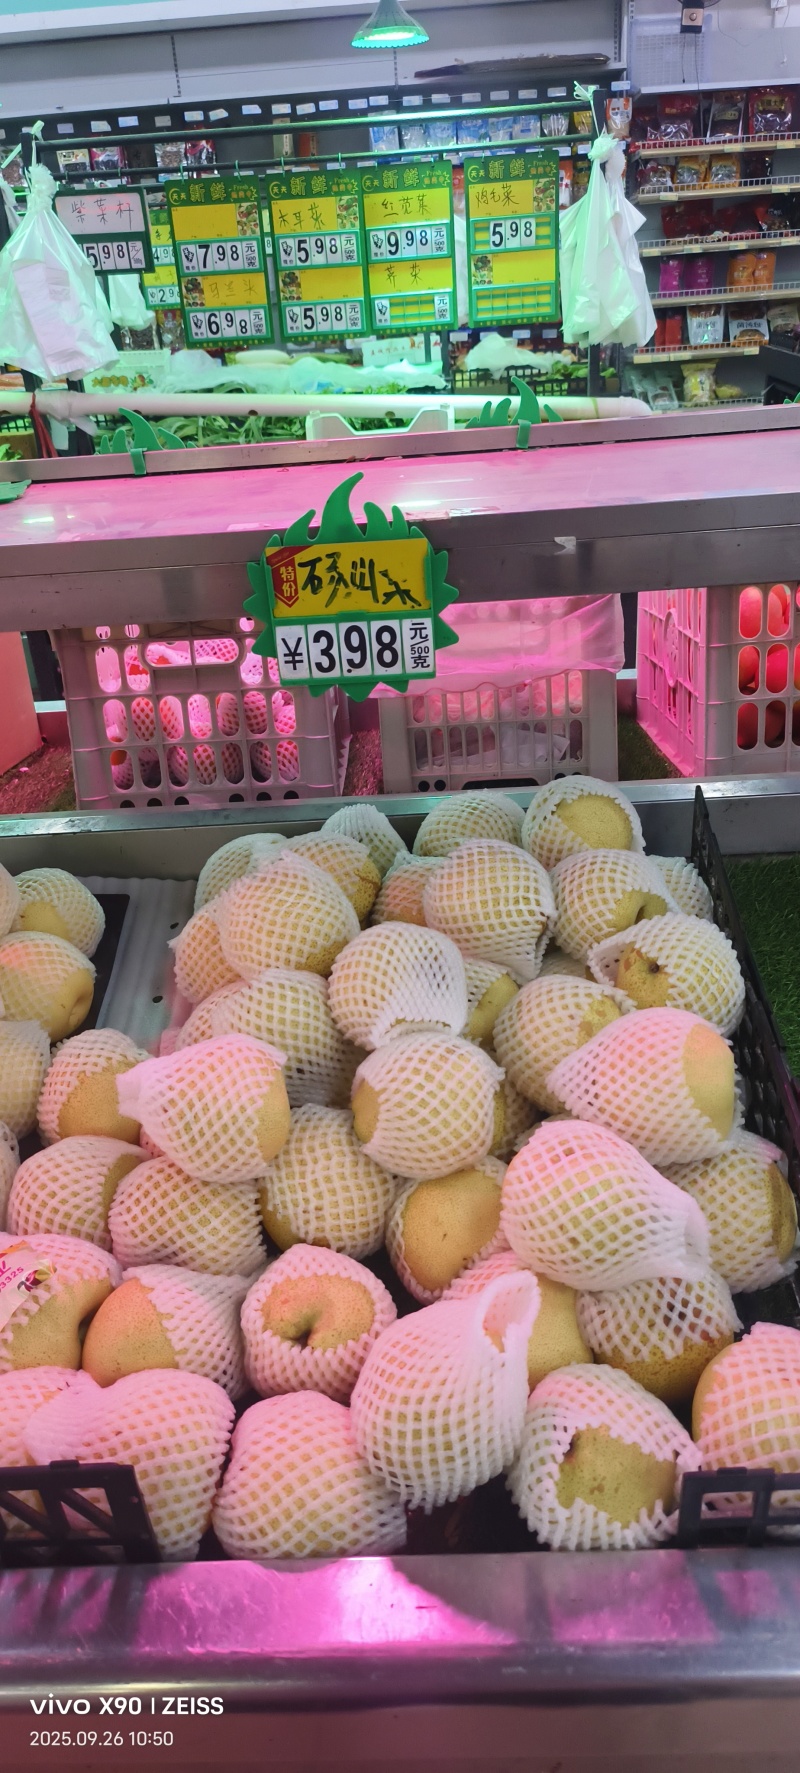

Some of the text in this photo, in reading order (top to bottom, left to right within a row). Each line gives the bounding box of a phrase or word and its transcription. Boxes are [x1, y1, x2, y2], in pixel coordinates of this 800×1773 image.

[383, 168, 419, 188] 新鲜
[489, 158, 525, 179] 新鲜
[189, 182, 226, 202] 新鲜
[290, 175, 327, 195] 新鲜
[476, 183, 520, 208] 鸡毛菜
[278, 202, 325, 230] 木耳菜
[387, 230, 428, 256] 9.98
[491, 221, 532, 248] 5.98
[85, 244, 125, 268] 5.98
[198, 244, 239, 269] 7.98
[297, 238, 338, 263] 5.98
[207, 312, 248, 335] 6.98
[303, 306, 343, 330] 5.98
[279, 566, 297, 597] 特价
[281, 624, 399, 674] ¥3.98
[0, 1267, 24, 1291] 3325
